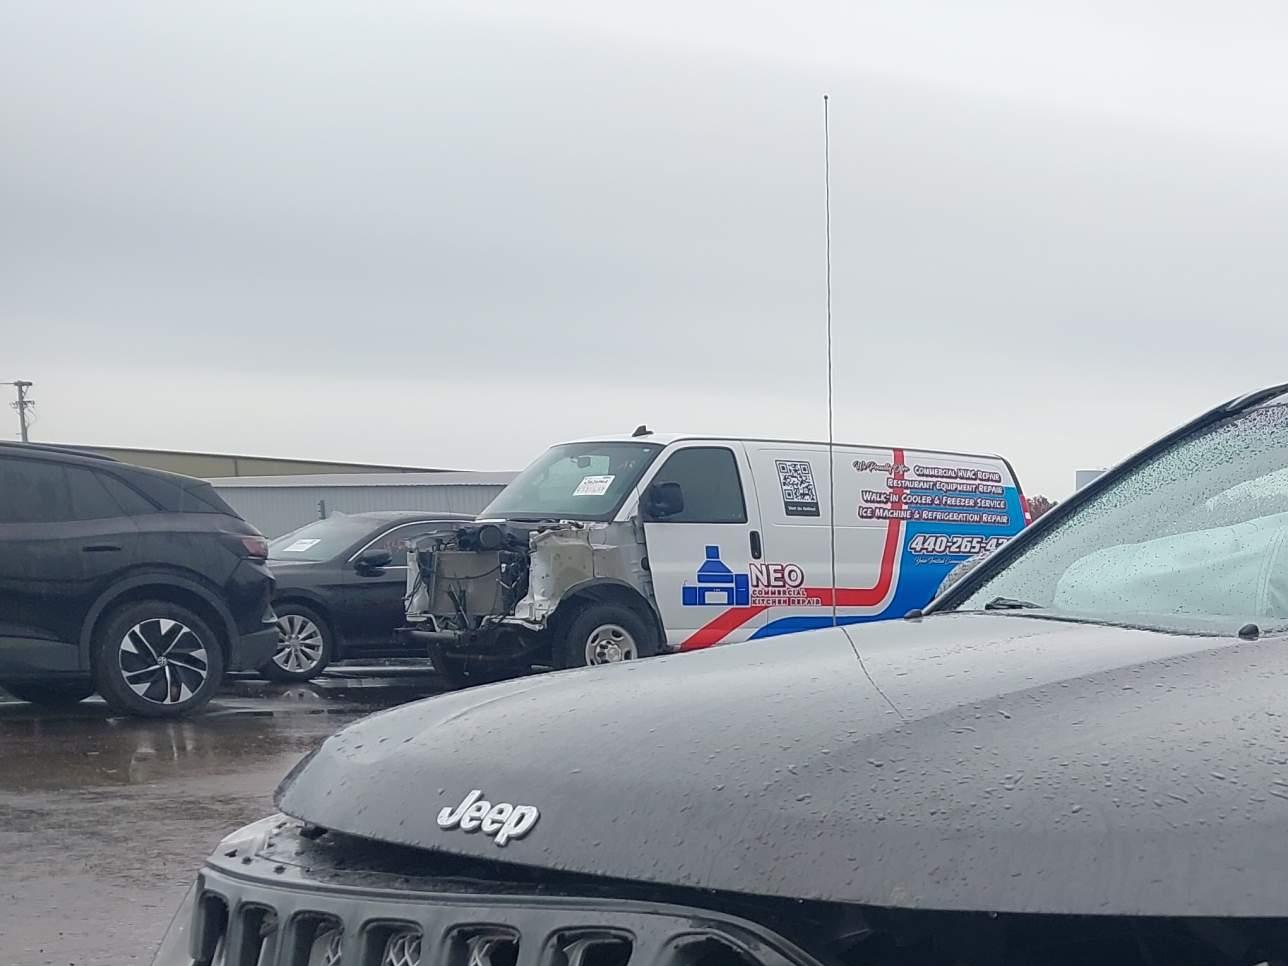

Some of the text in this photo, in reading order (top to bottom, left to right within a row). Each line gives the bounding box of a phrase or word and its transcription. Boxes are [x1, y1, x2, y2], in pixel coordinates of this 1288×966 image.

[914, 465, 956, 478] COMMERCIAL
[957, 469, 975, 480] HVAC
[977, 470, 1001, 482] REPAIR
[887, 478, 1003, 495] RESTAURANT EQUIPMENT REPAIR
[862, 490, 1005, 509] WALK-IN COOLER & FREEZER SERVICE
[858, 506, 1009, 524] ICE MACHINE & REFRIGERATION REPAIR
[750, 563, 804, 588] NEO
[752, 598, 821, 606] KITCHEN REPAIR
[436, 789, 541, 847] Jeep
